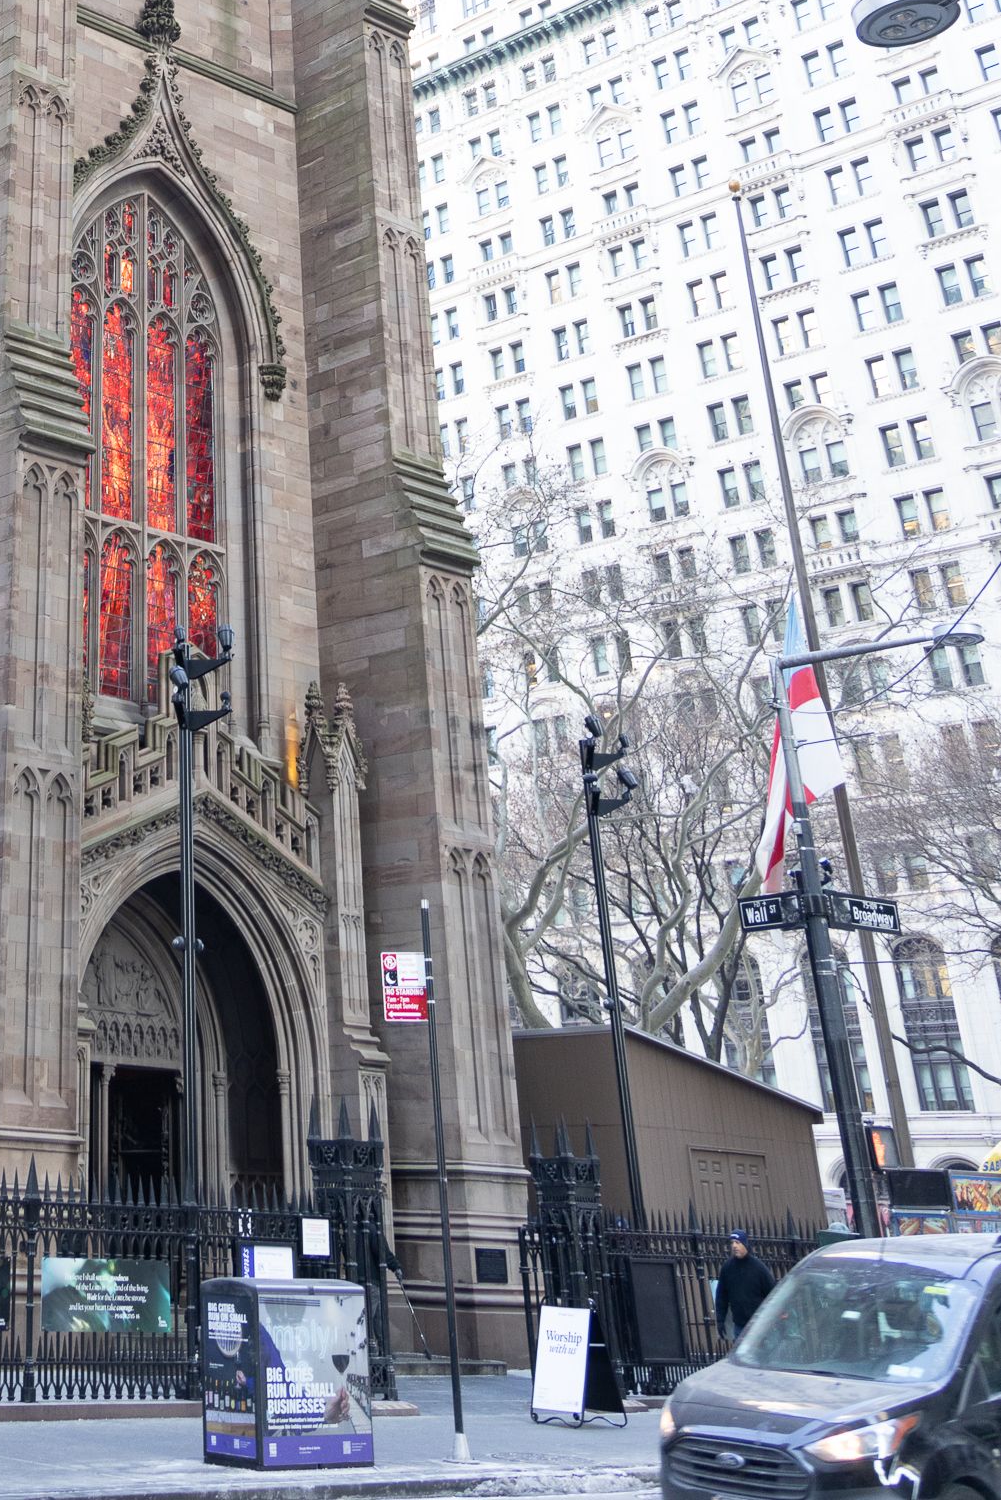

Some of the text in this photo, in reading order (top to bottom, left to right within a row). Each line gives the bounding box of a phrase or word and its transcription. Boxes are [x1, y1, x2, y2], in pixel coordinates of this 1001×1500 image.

[745, 906, 768, 924] Wall
[769, 904, 776, 914] ST
[852, 906, 894, 928] Broadway
[208, 1302, 235, 1313] BIG CITIES
[229, 1313, 248, 1324] SMALL
[208, 1321, 241, 1332] BUSINESSES
[546, 1329, 582, 1347] Worship
[549, 1344, 567, 1355] with
[266, 1367, 314, 1382] BIG CITIES
[266, 1382, 336, 1398] RUN ON SMALL
[267, 1398, 326, 1414] BUSINESSES
